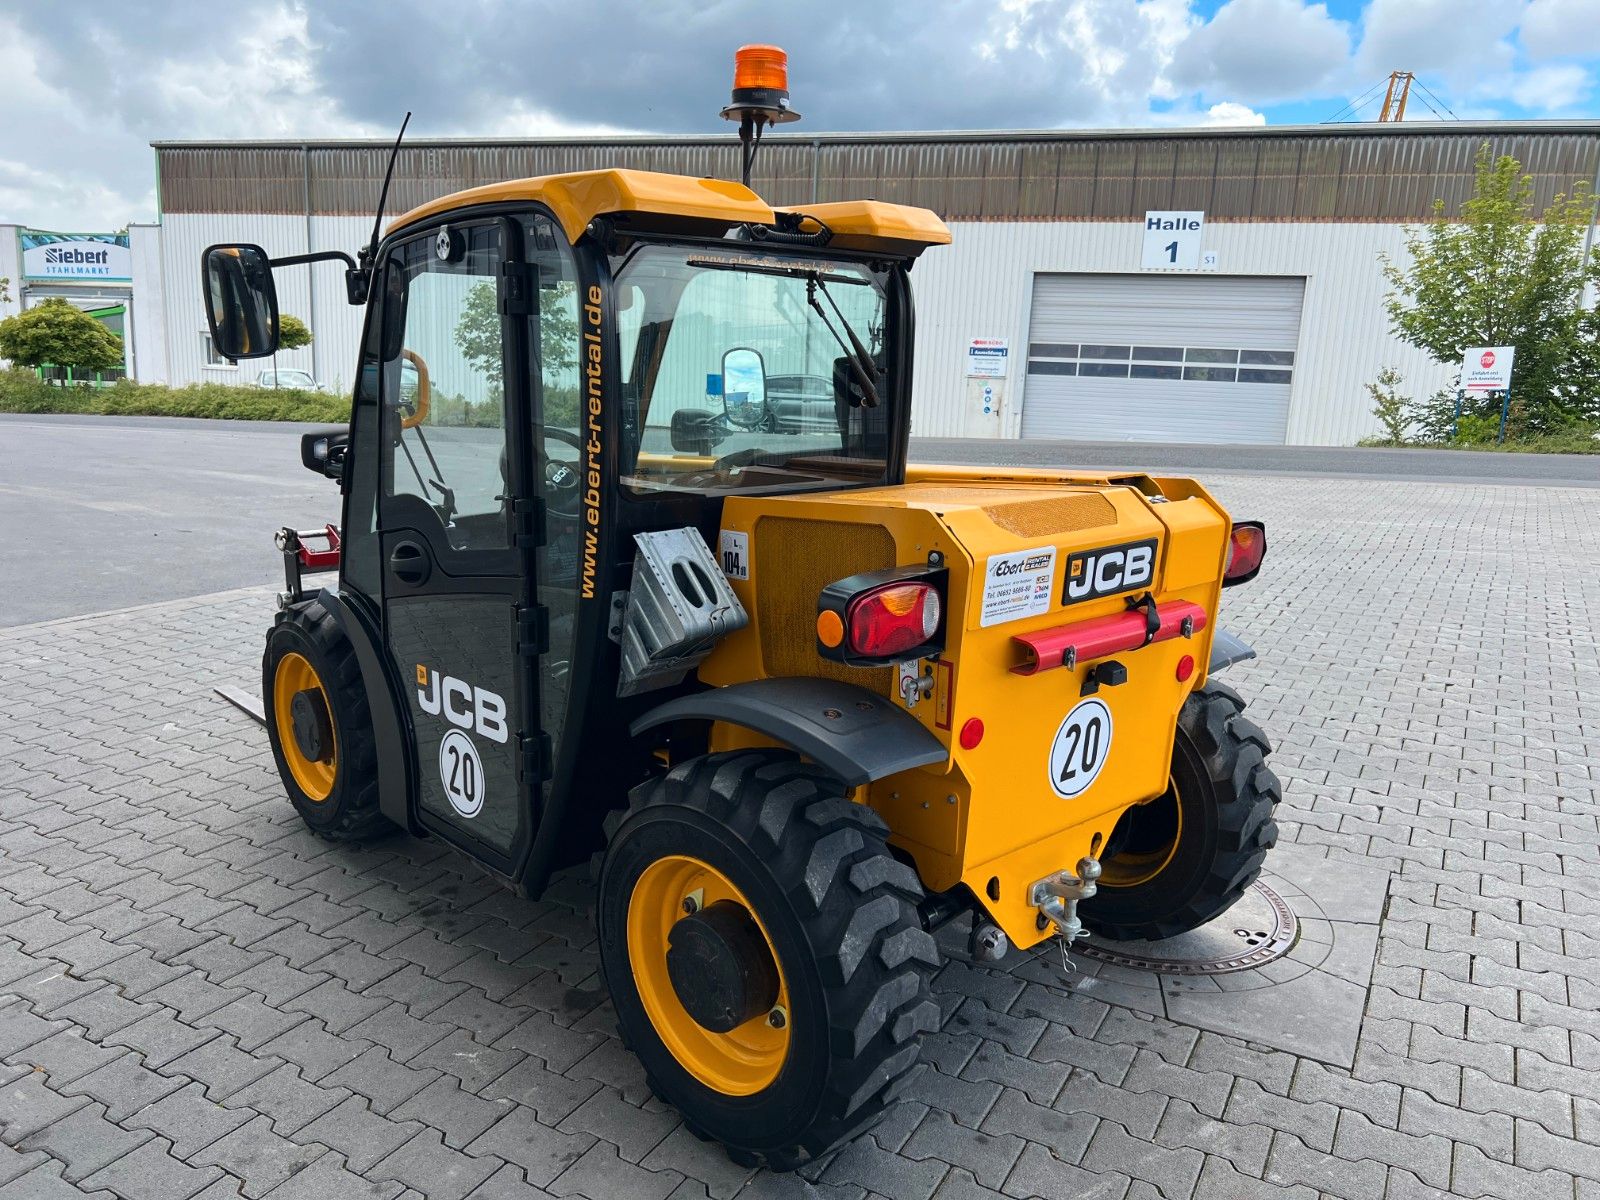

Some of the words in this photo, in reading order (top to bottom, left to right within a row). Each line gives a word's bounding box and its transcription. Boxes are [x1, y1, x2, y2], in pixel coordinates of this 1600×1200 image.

[1147, 218, 1200, 231] Halle
[45, 248, 108, 264] Siebert
[1165, 241, 1178, 263] 1
[46, 266, 109, 275] STAHLMARKT
[581, 285, 602, 599] www.ebert-rental.de
[724, 551, 740, 575] 104
[996, 559, 1025, 576] Ebert
[1068, 546, 1152, 598] JCB
[418, 669, 509, 744] JCB
[1060, 716, 1102, 783] 20
[448, 745, 475, 803] 20
